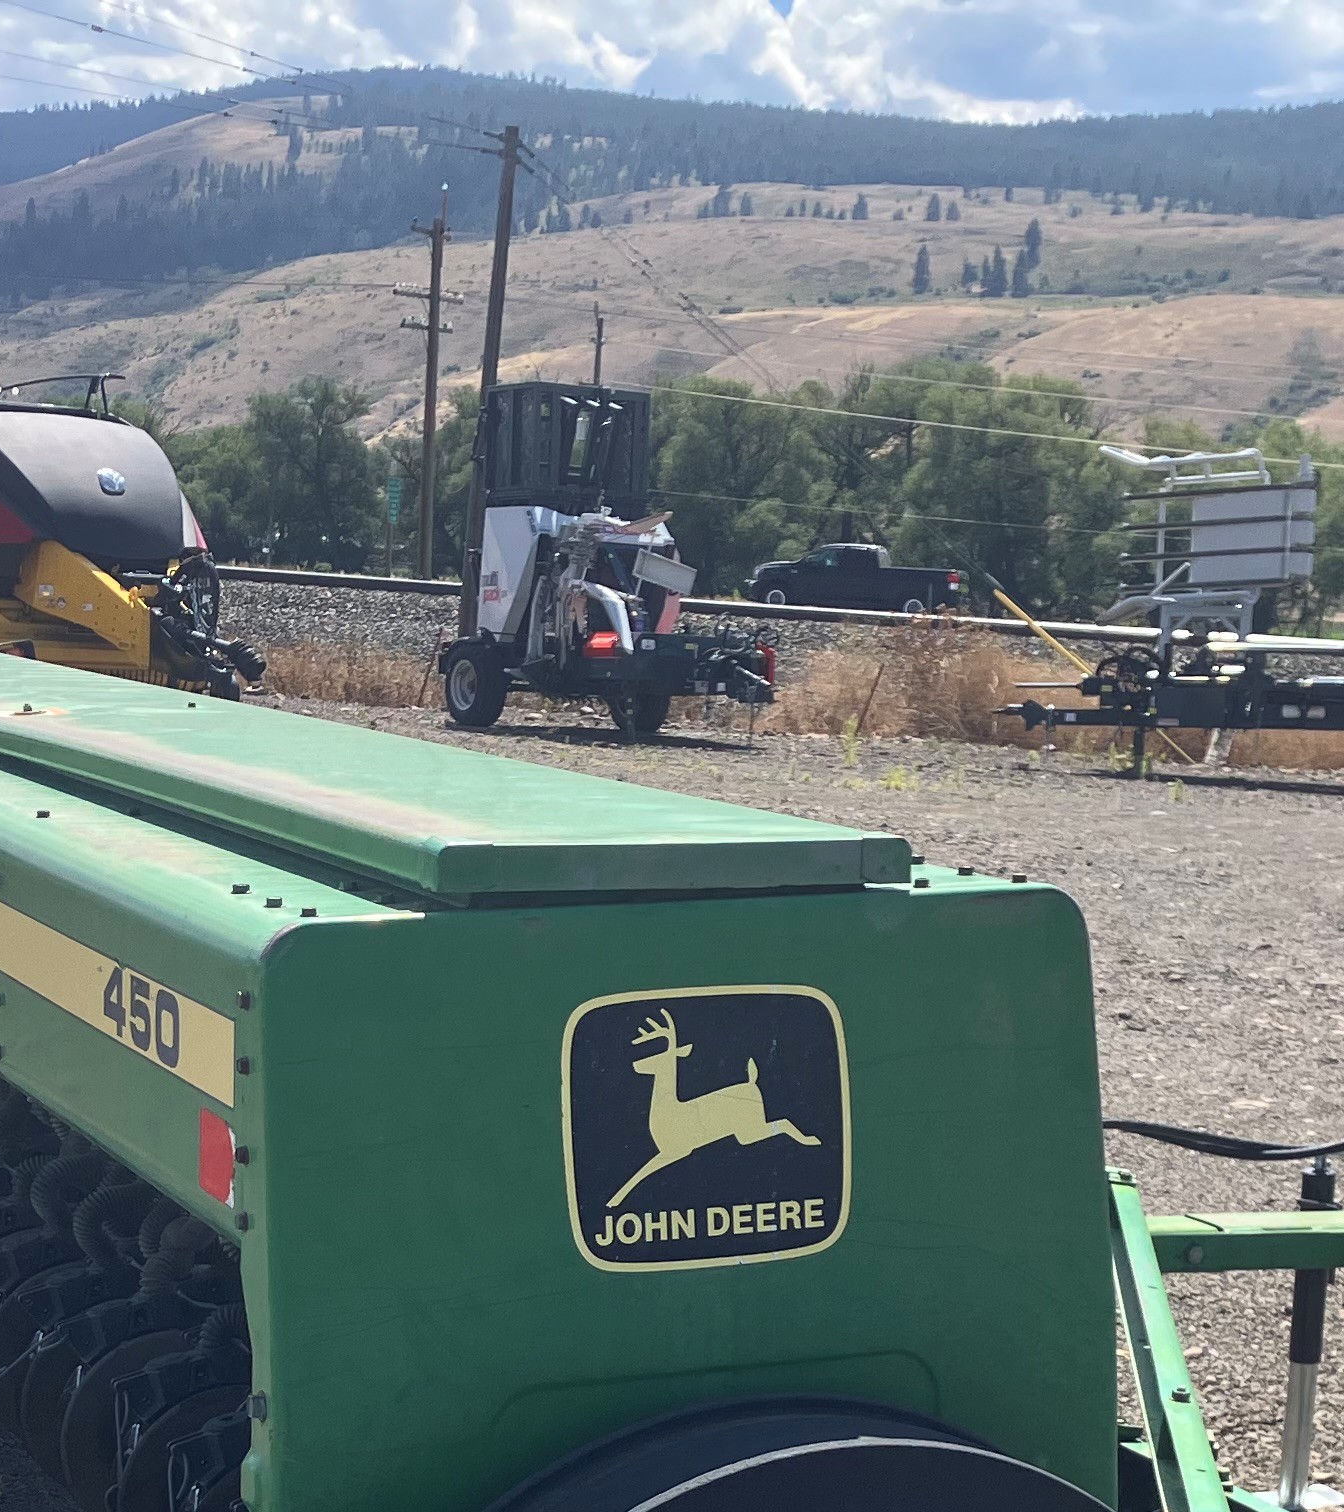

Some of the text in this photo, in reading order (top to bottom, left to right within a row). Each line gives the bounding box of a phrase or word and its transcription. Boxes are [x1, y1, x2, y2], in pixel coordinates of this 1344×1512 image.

[103, 965, 180, 1069] 450
[595, 1198, 825, 1247] JOHN DEERE
